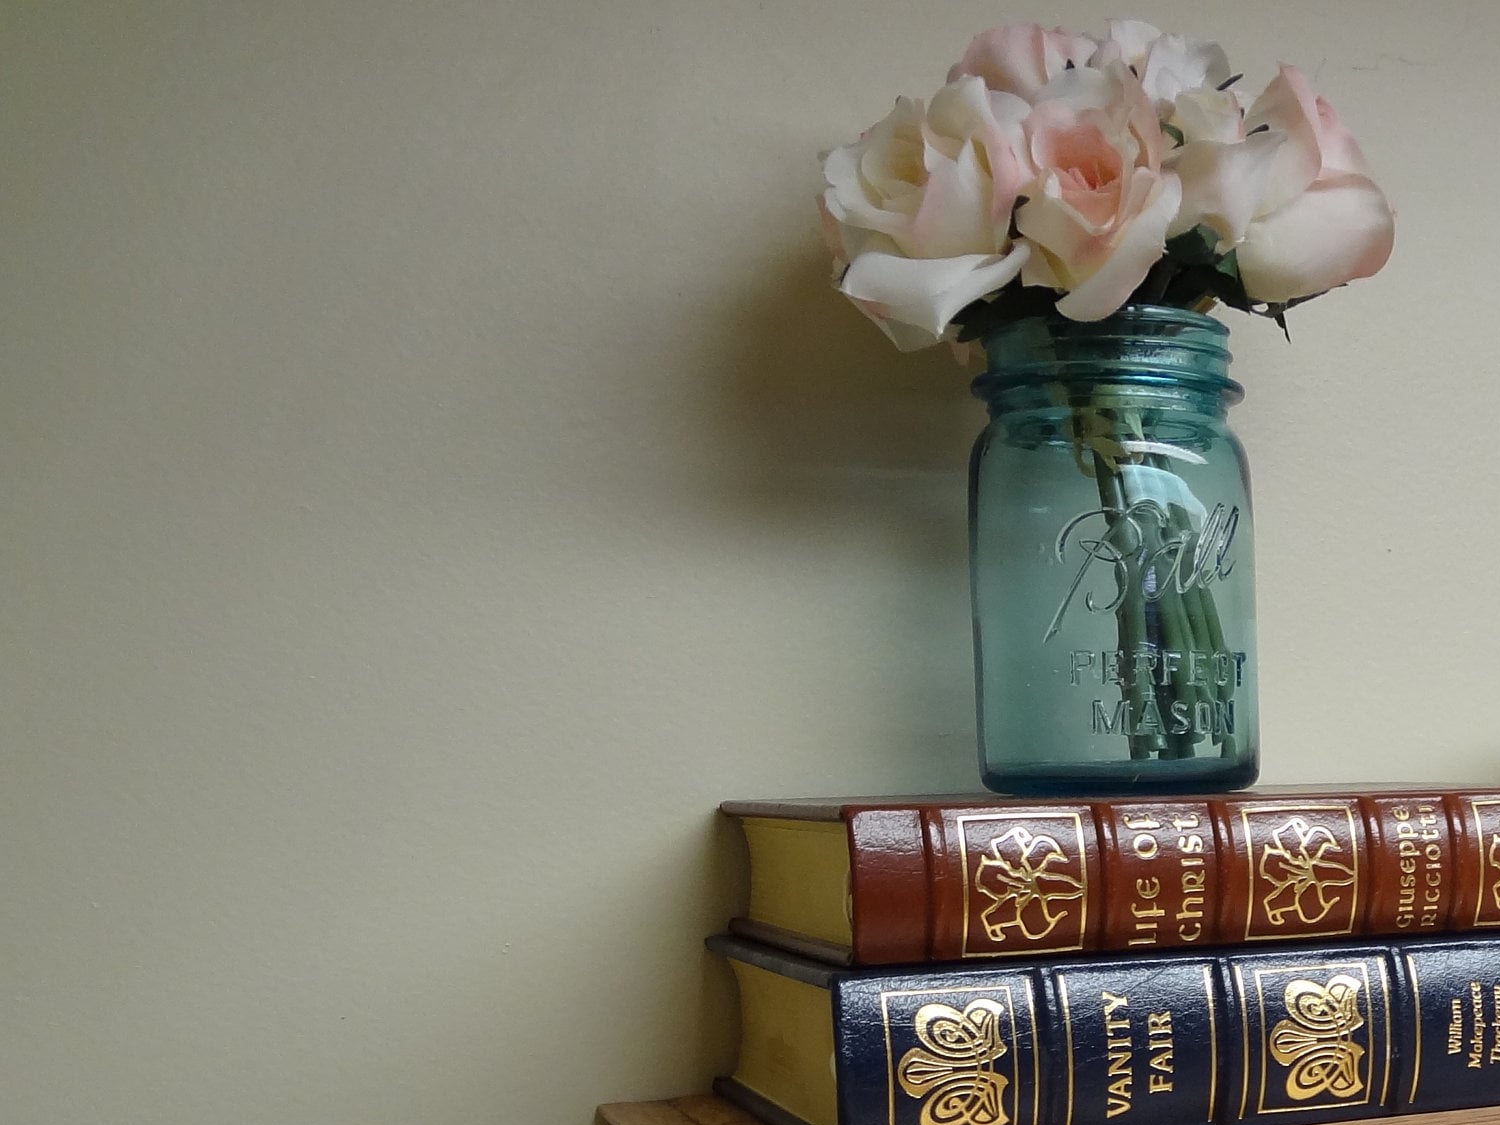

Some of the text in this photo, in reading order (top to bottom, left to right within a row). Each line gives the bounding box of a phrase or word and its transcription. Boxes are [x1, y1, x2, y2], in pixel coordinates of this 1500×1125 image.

[1044, 500, 1239, 643] Ball
[1069, 650, 1247, 687] PERFECT
[1091, 699, 1236, 735] MASON
[1102, 991, 1132, 1119] VANITY
[1147, 1010, 1173, 1094] FAIR
[1447, 998, 1463, 1055] William
[1467, 981, 1487, 1069] Makepeace
